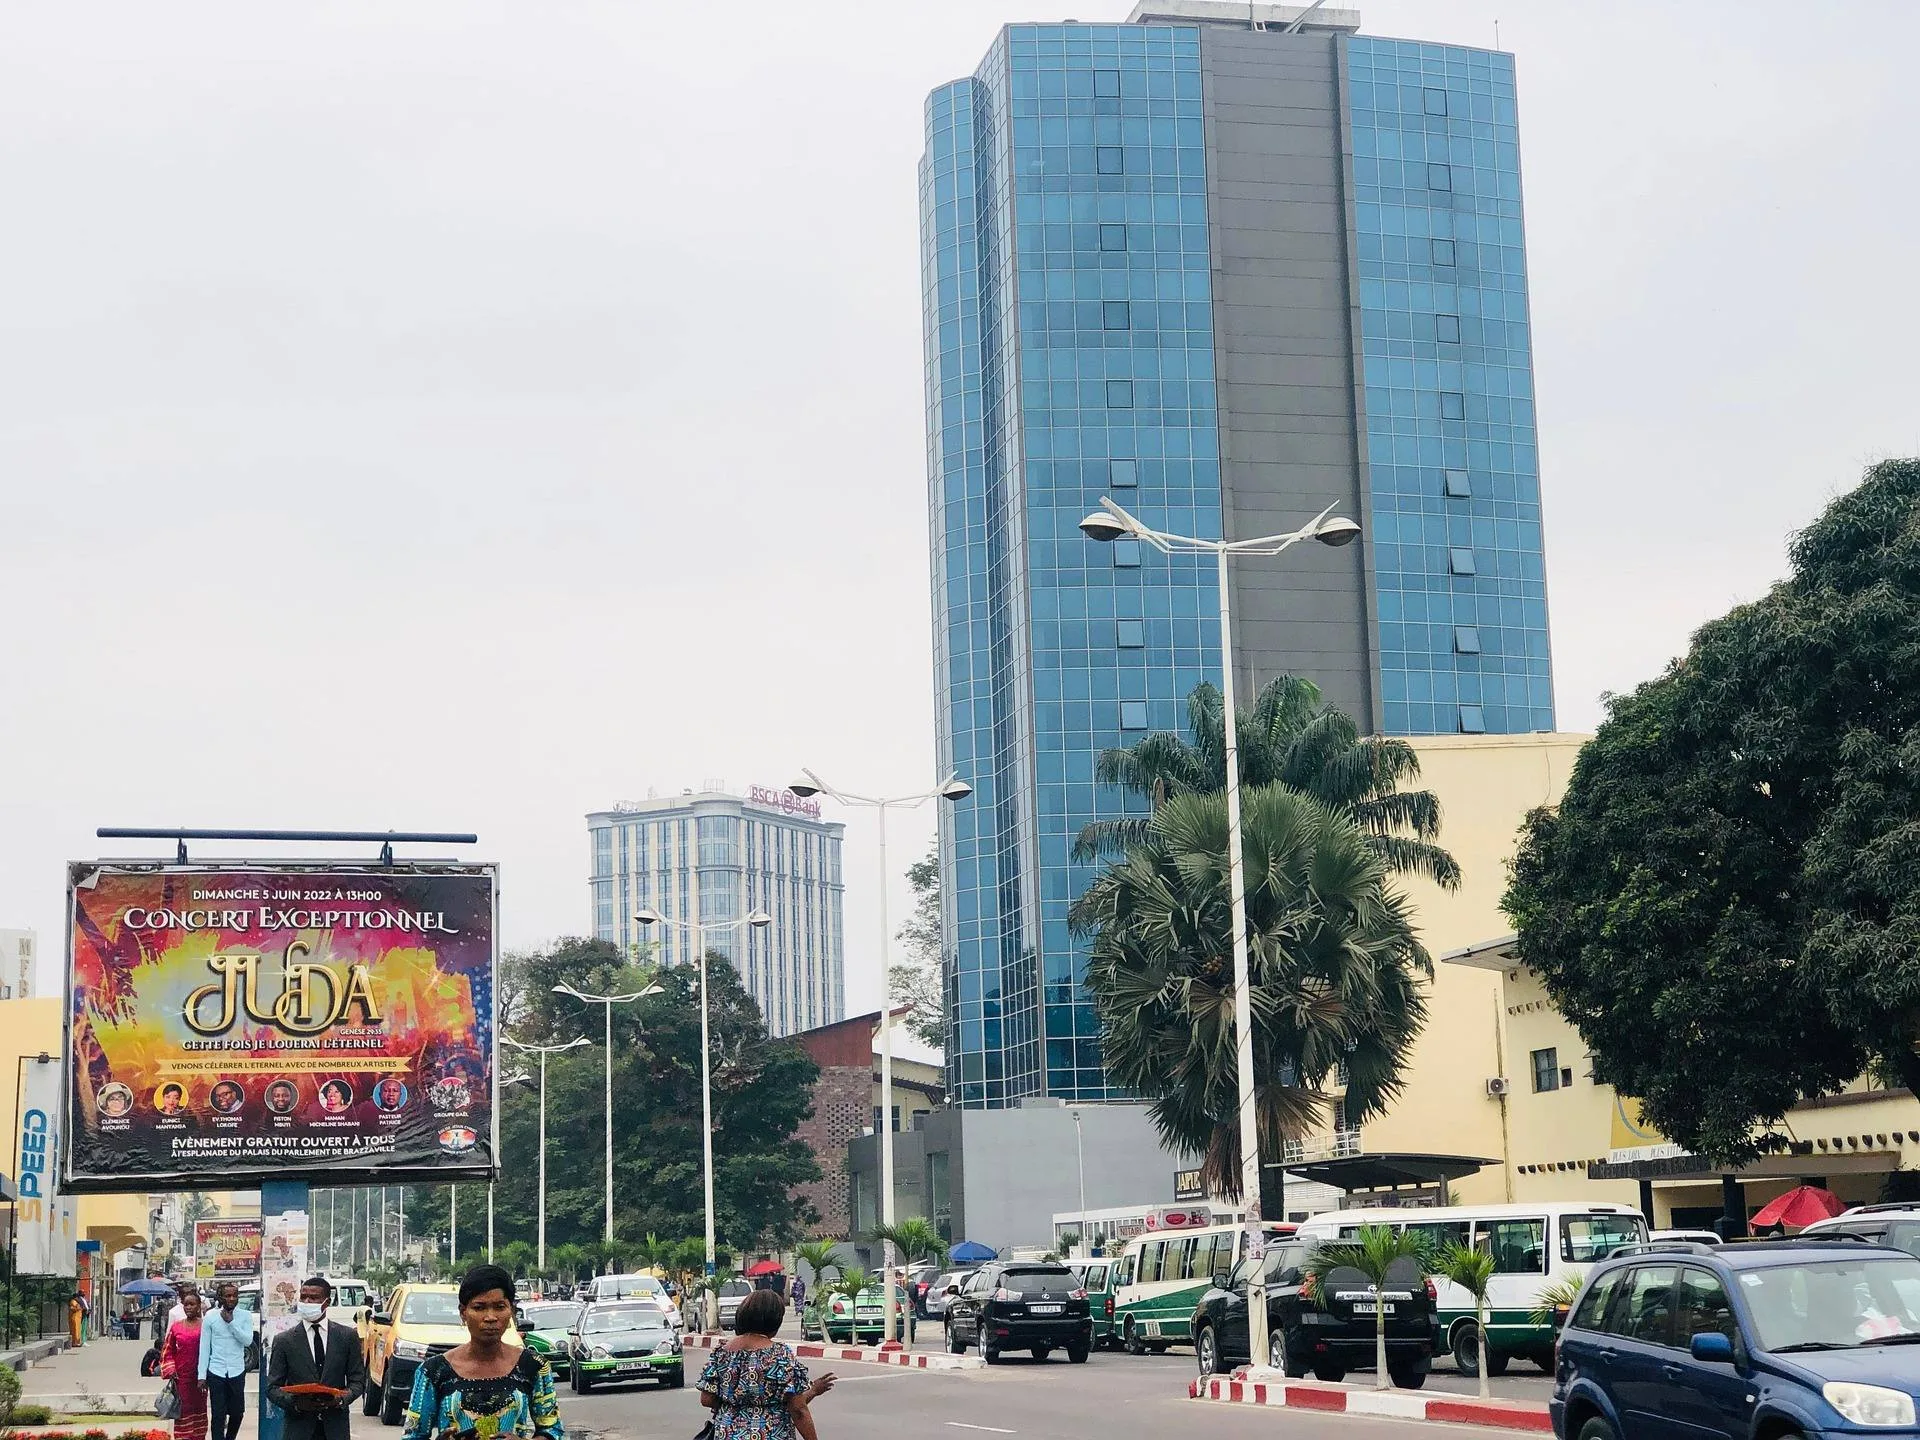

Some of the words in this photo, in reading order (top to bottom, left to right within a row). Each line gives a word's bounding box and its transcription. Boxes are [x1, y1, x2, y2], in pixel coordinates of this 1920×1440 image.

[751, 786, 780, 808] BSCA
[795, 796, 821, 818] Bank
[193, 889, 260, 900] DIMANCHE
[262, 890, 269, 900] 5
[271, 889, 300, 900] JUIN
[303, 890, 332, 900] 2022
[334, 888, 344, 900] À
[346, 889, 382, 900] 13H00
[123, 907, 254, 932] CONCERT
[258, 905, 460, 934] EXCEPTIONNEL
[184, 940, 384, 1033] JUDA
[182, 1039, 222, 1050] CETTE
[224, 1039, 252, 1050] FOIS
[253, 1039, 266, 1051] JE
[268, 1039, 320, 1049] LOUERAI
[171, 1062, 204, 1070] VENONS
[204, 1060, 243, 1070] CÉLÉBRER
[285, 1061, 306, 1069] AVEC
[318, 1060, 361, 1068] NOMBREUX
[363, 1060, 397, 1068] ARTISTES
[171, 1136, 242, 1149] ÉVÈNEMENT
[246, 1137, 299, 1147] GRATUIT
[300, 1136, 350, 1147] OUVERT
[352, 1134, 362, 1146] À
[363, 1135, 396, 1144] TOUS
[242, 1148, 270, 1156] PALAIS
[284, 1148, 331, 1156] PARLEMENT
[343, 1145, 396, 1155] BRAZZAVILLE
[20, 1108, 47, 1224] SPEED
